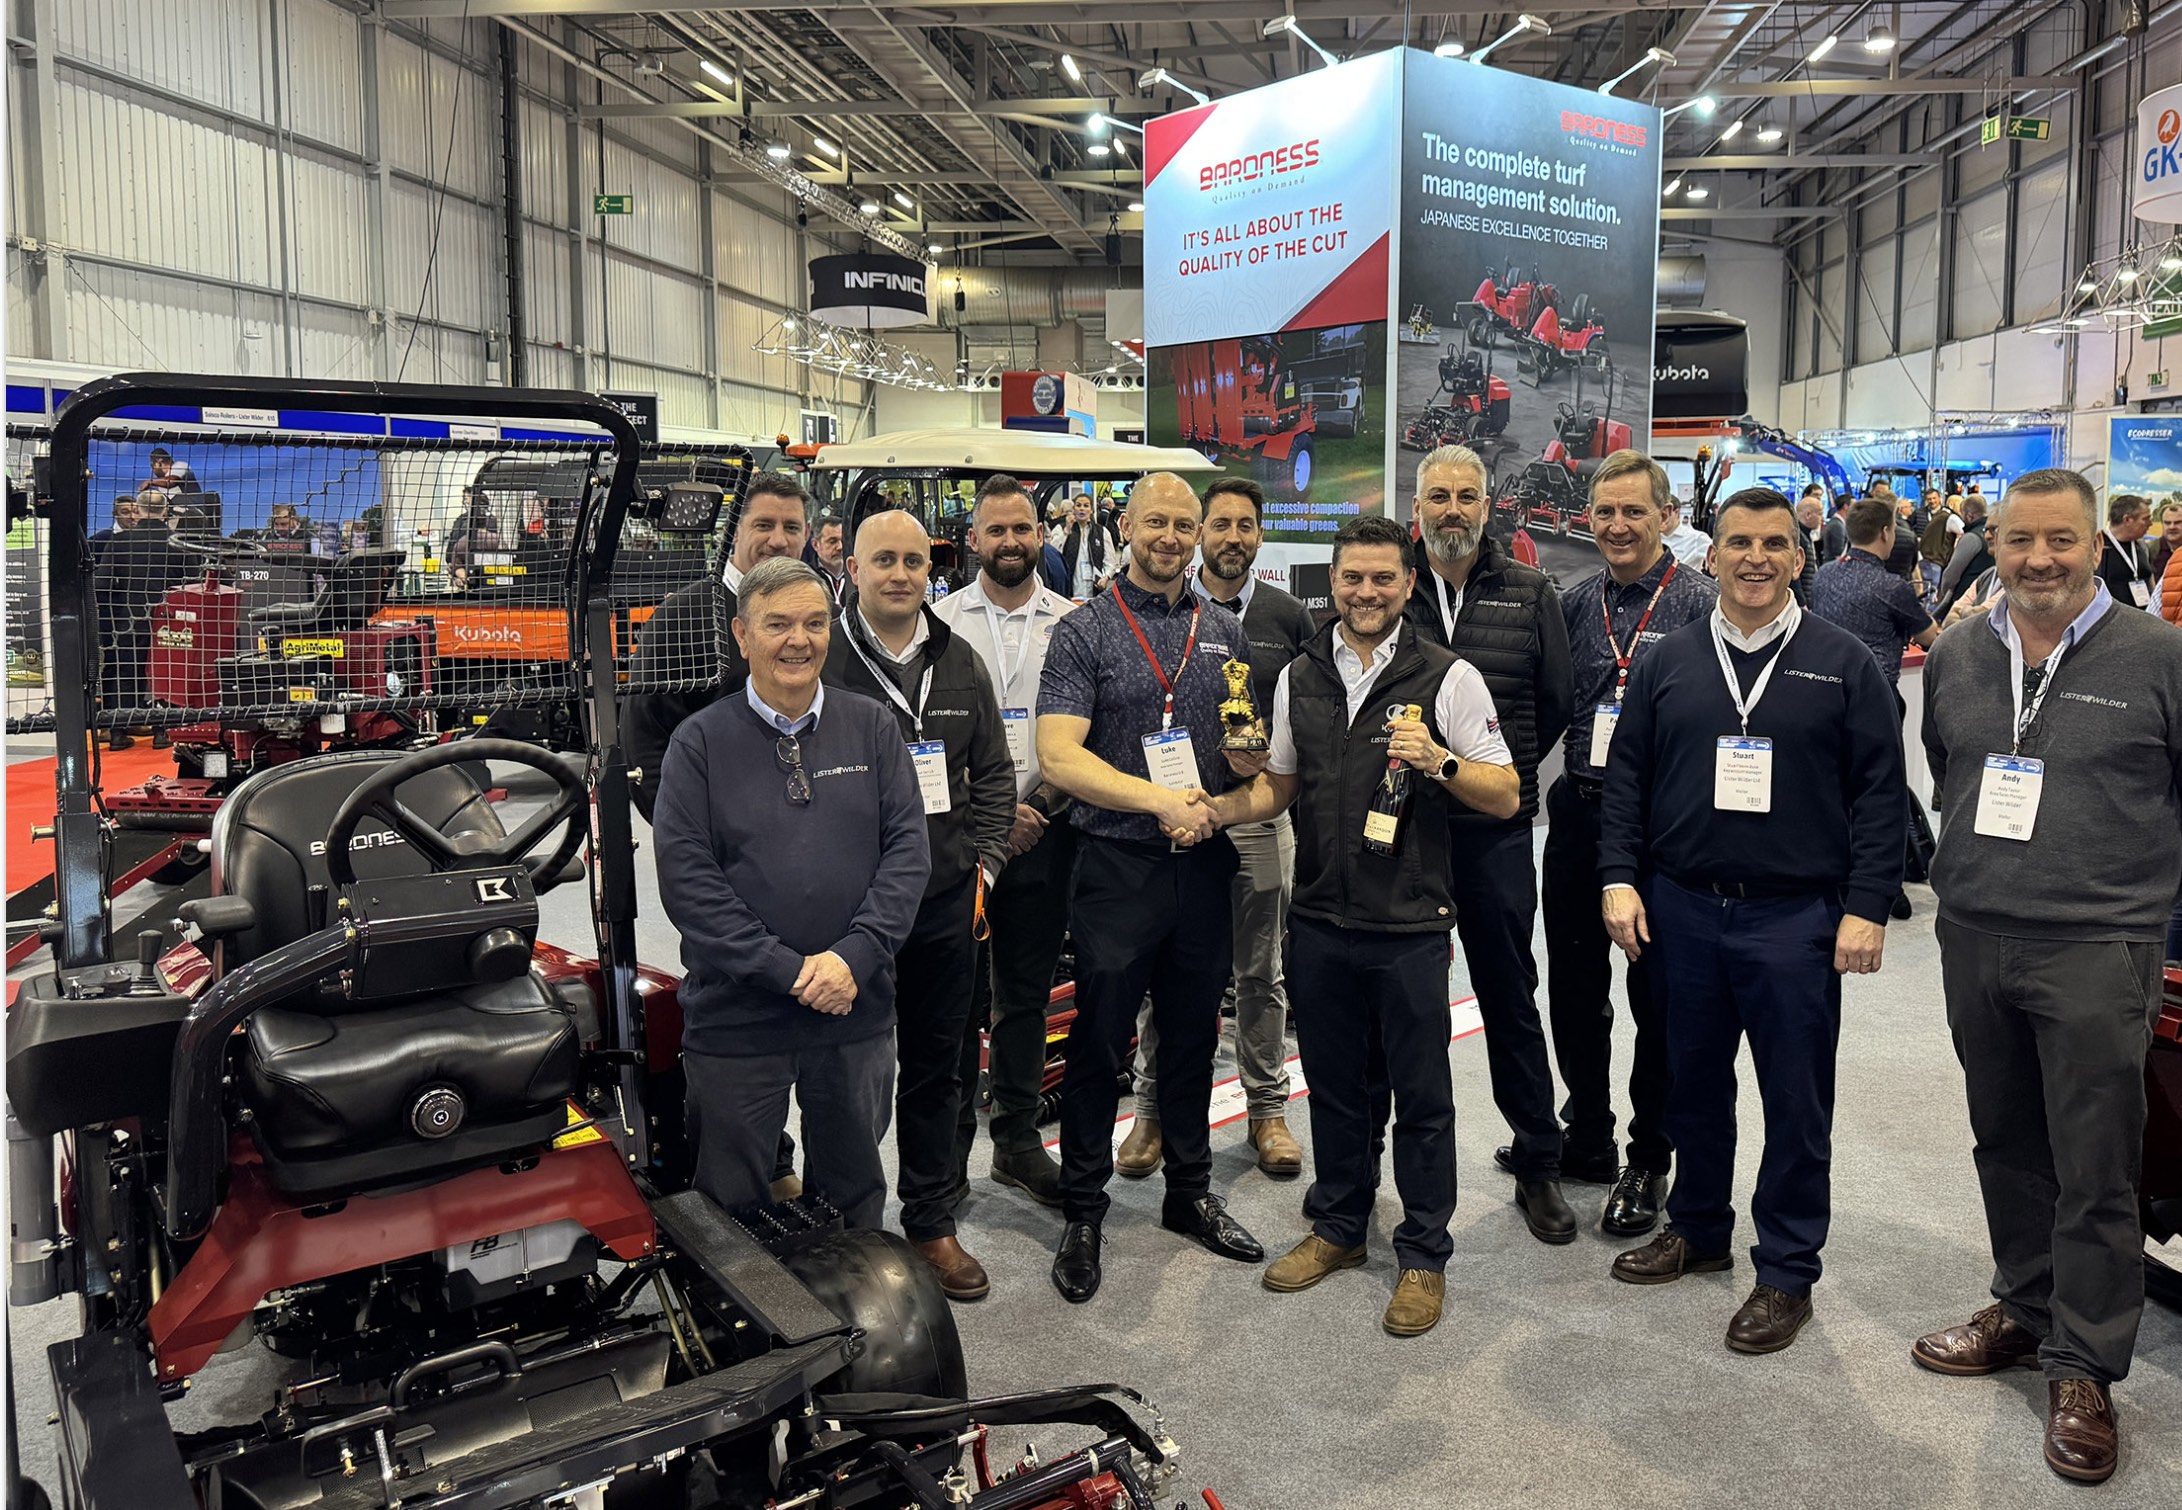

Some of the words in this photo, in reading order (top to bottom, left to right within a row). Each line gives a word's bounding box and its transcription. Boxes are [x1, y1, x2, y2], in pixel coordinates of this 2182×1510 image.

[1561, 111, 1647, 148] BARONESS
[1570, 136, 1596, 150] Quality
[1611, 144, 1637, 157] Demand
[1200, 139, 1319, 191] BARONESS
[1422, 132, 1460, 164] The
[1465, 146, 1550, 181] complete
[1555, 159, 1586, 187] turf
[1212, 190, 1246, 205] Quality
[1268, 175, 1305, 191] Demand
[1421, 174, 1546, 214] management
[1550, 193, 1621, 225] solution.
[1183, 230, 1209, 250] IT'S
[1214, 224, 1241, 244] ALL
[1246, 211, 1303, 238] ABOUT
[1309, 203, 1342, 226] THE
[1421, 209, 1479, 232] JAPANESE
[1482, 218, 1551, 242] EXCELLENCE
[1553, 228, 1608, 250] TOGETHER
[1179, 250, 1243, 276] QUALITY
[1248, 245, 1269, 264] OF
[1275, 238, 1306, 260] THE
[1312, 231, 1348, 254] CUT
[621, 402, 637, 412] THE
[1270, 502, 1309, 515] excessive
[1310, 501, 1360, 515] compaction
[1274, 518, 1308, 531] valuable
[1309, 519, 1340, 532] greens.
[240, 571, 269, 580] TB-270
[1258, 569, 1285, 582] WALL
[455, 625, 521, 643] Kubota
[1784, 669, 1809, 680] LISTER
[2060, 691, 2086, 702] LISTER
[2093, 696, 2128, 710] WILDER
[1161, 746, 1176, 754] Luke
[1733, 751, 1754, 760] Stuart
[813, 768, 837, 778] LISTER
[841, 765, 869, 774] WILDER
[2001, 774, 2021, 784] Andy
